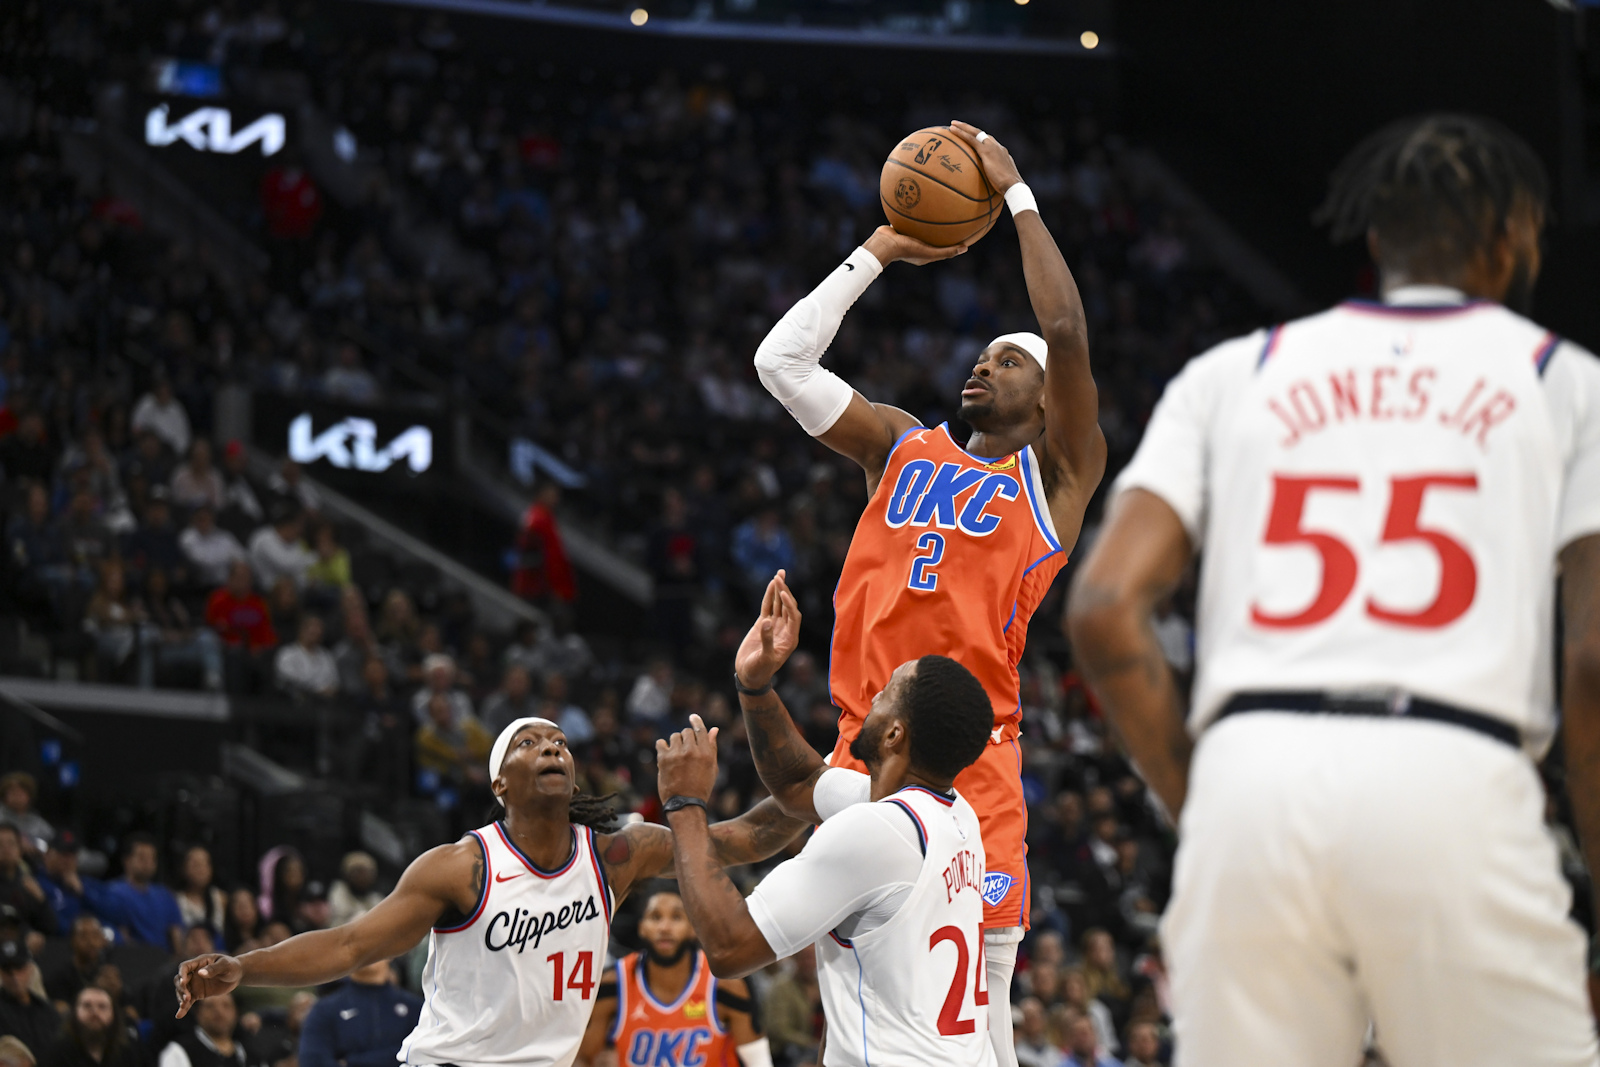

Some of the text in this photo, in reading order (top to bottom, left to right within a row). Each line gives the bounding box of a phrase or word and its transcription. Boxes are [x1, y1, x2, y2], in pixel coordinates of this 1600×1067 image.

[1267, 365, 1518, 454] JONES JR
[885, 459, 1020, 537] OKC
[907, 531, 946, 592] 2
[1249, 470, 1479, 632] 55
[485, 894, 600, 954] Clippers
[546, 951, 596, 1001] 14
[625, 1026, 714, 1067] OKC
